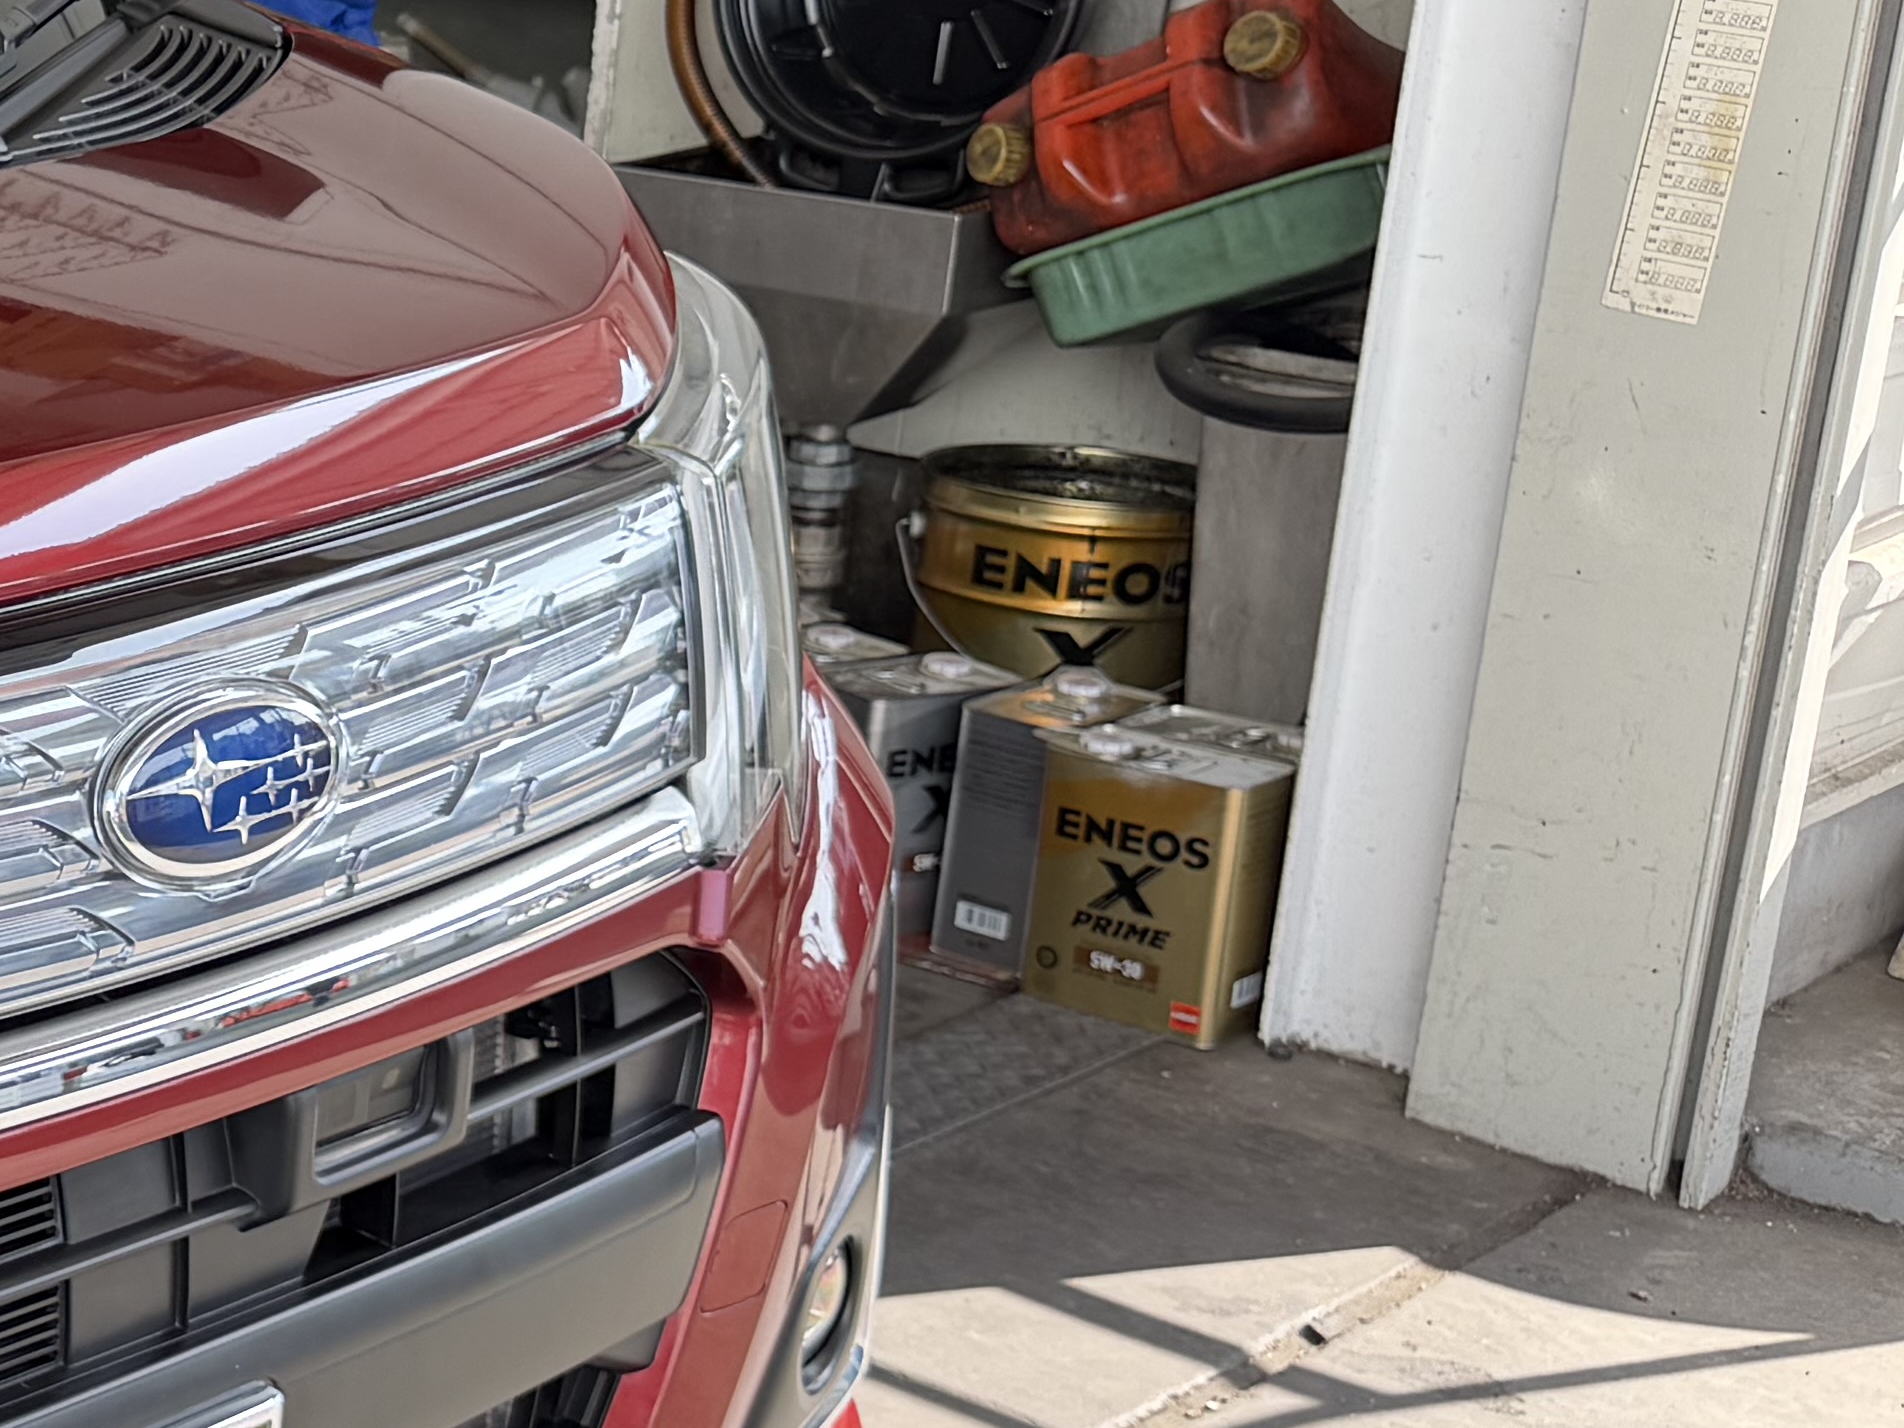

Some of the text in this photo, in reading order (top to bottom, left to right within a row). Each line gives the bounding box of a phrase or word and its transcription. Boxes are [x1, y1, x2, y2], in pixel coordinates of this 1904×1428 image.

[1056, 805, 1211, 870] ENEOS
[1087, 856, 1166, 919] X
[1071, 909, 1172, 951] PRIME
